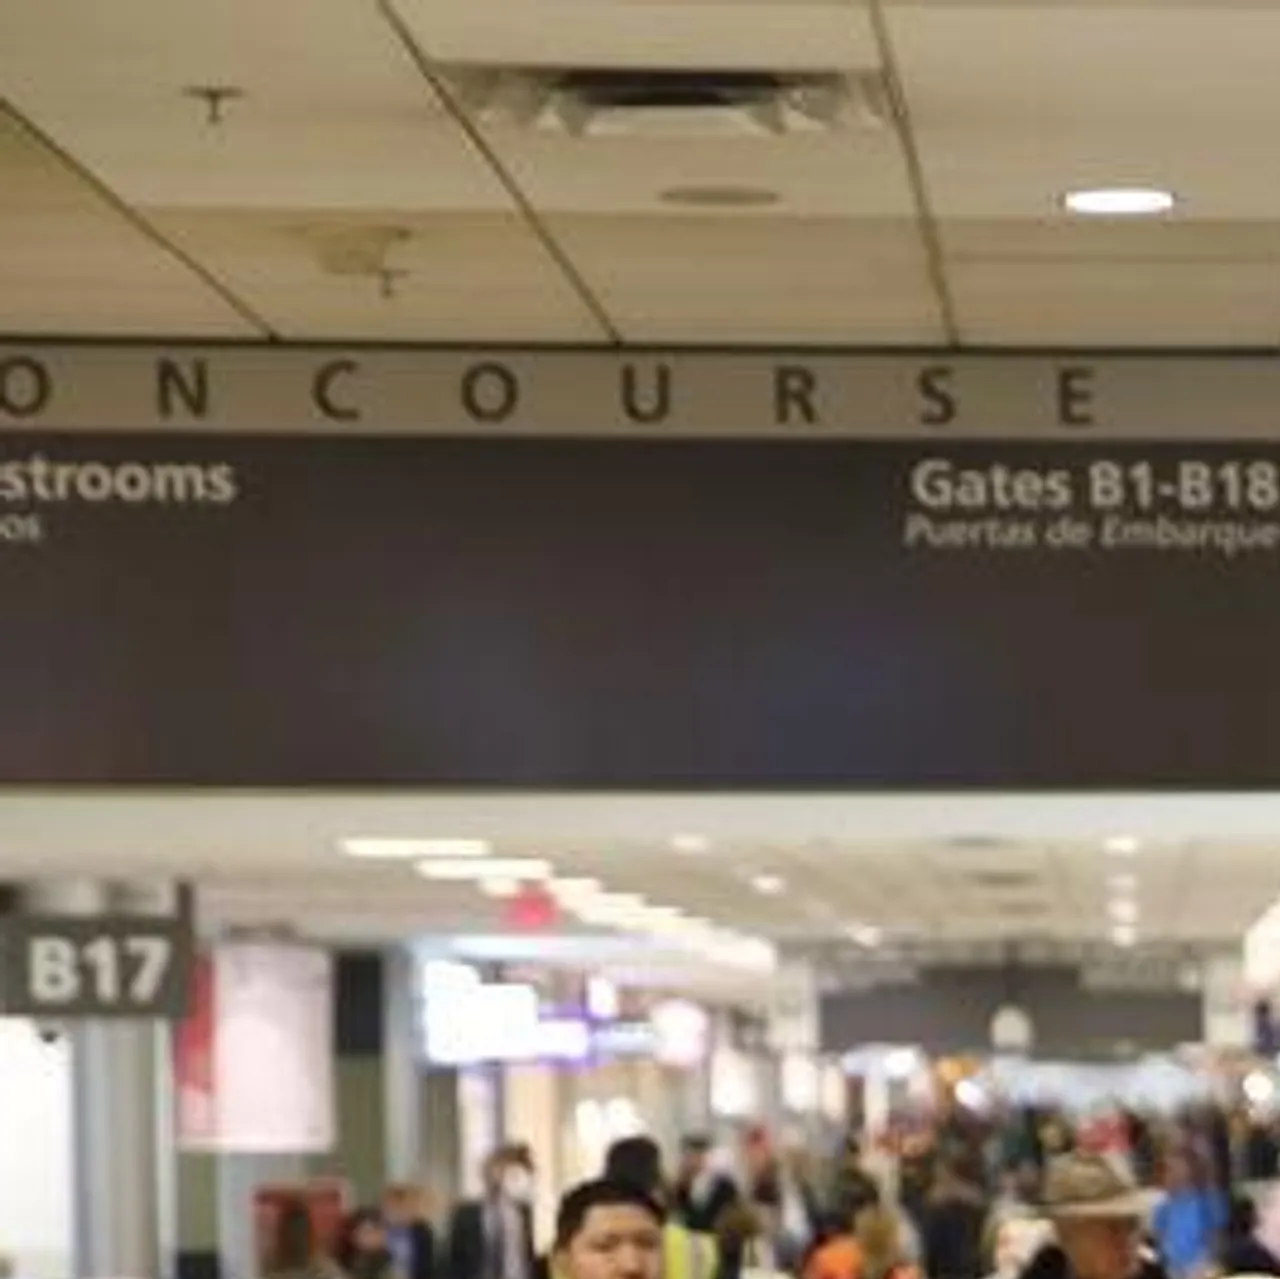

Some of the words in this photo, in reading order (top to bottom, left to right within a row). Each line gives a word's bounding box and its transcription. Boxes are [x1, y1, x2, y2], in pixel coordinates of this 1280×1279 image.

[0, 454, 236, 503] strooms
[911, 458, 1072, 509] Gates
[904, 514, 1035, 547] Puertas
[1046, 514, 1093, 544] de
[29, 935, 172, 1002] B17
